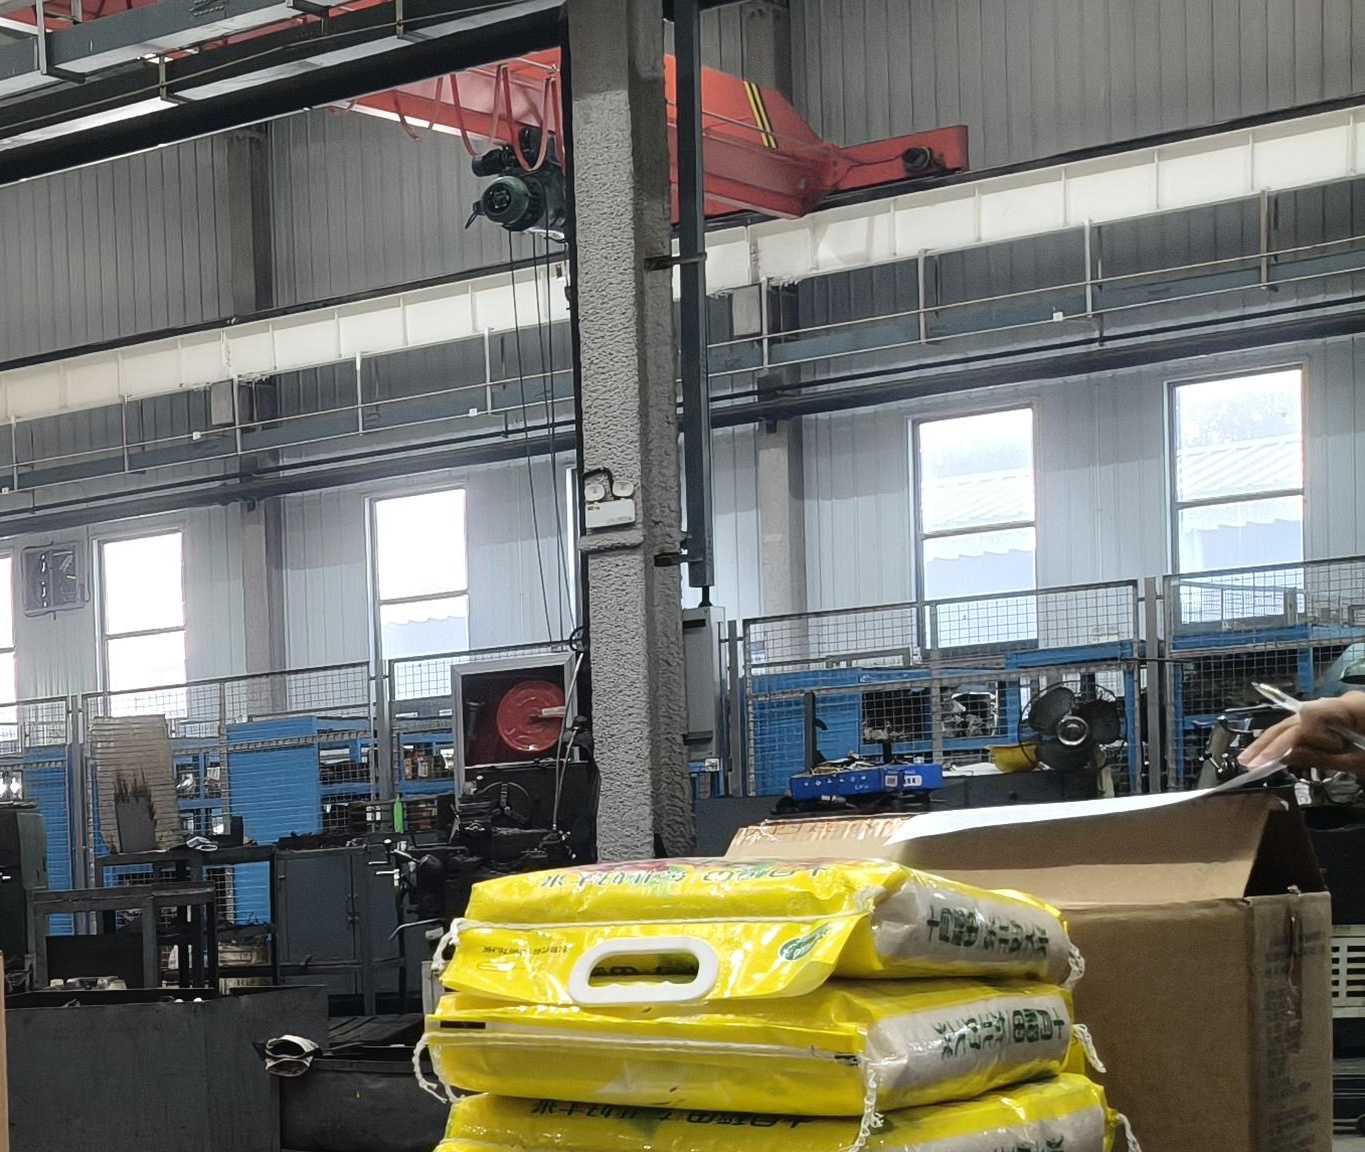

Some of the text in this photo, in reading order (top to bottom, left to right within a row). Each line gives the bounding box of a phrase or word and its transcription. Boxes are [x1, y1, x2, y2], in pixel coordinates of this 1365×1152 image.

[927, 905, 980, 948] 十月稻田
[1013, 1007, 1065, 1043] 十月稻田
